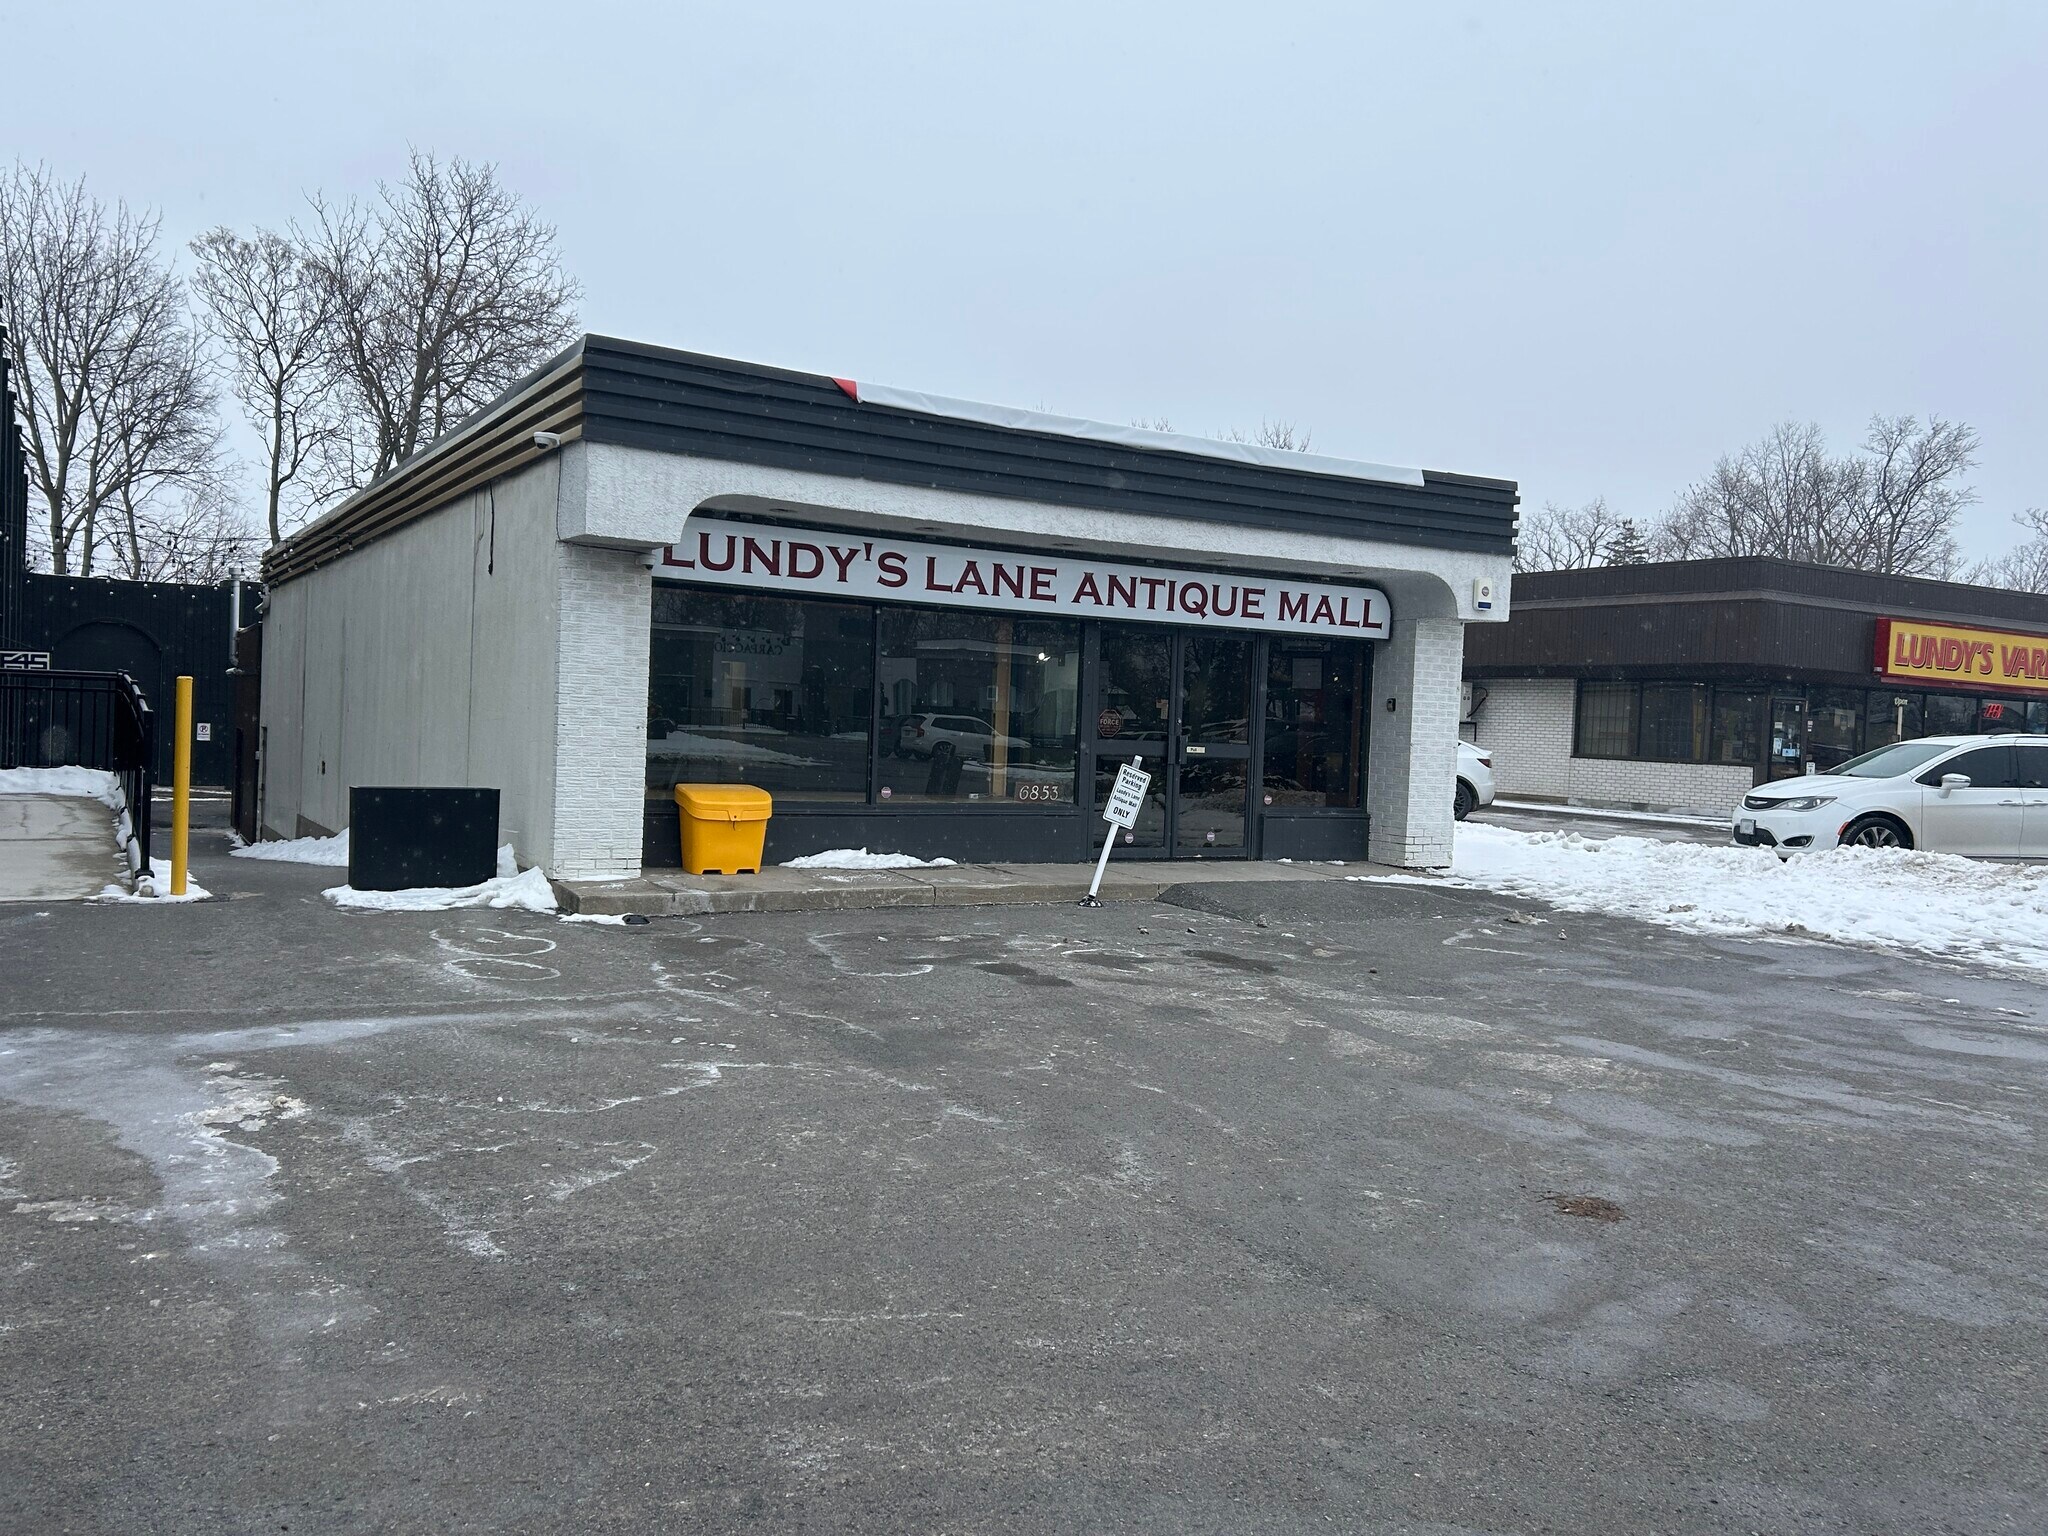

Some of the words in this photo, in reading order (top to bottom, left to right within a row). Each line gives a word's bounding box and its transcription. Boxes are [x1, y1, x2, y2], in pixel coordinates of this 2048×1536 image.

[661, 532, 908, 587] LUNDY'S
[925, 556, 1057, 602] LANE
[1071, 572, 1266, 620] ANTIQUE
[1278, 591, 1383, 630] MALL
[1894, 632, 1994, 674] LUNDY'S
[1100, 718, 1120, 726] FORCE
[1121, 776, 1142, 791] Parking
[1122, 768, 1147, 784] Reserved
[1020, 785, 1059, 800] 6853
[1112, 806, 1130, 819] ONLY
